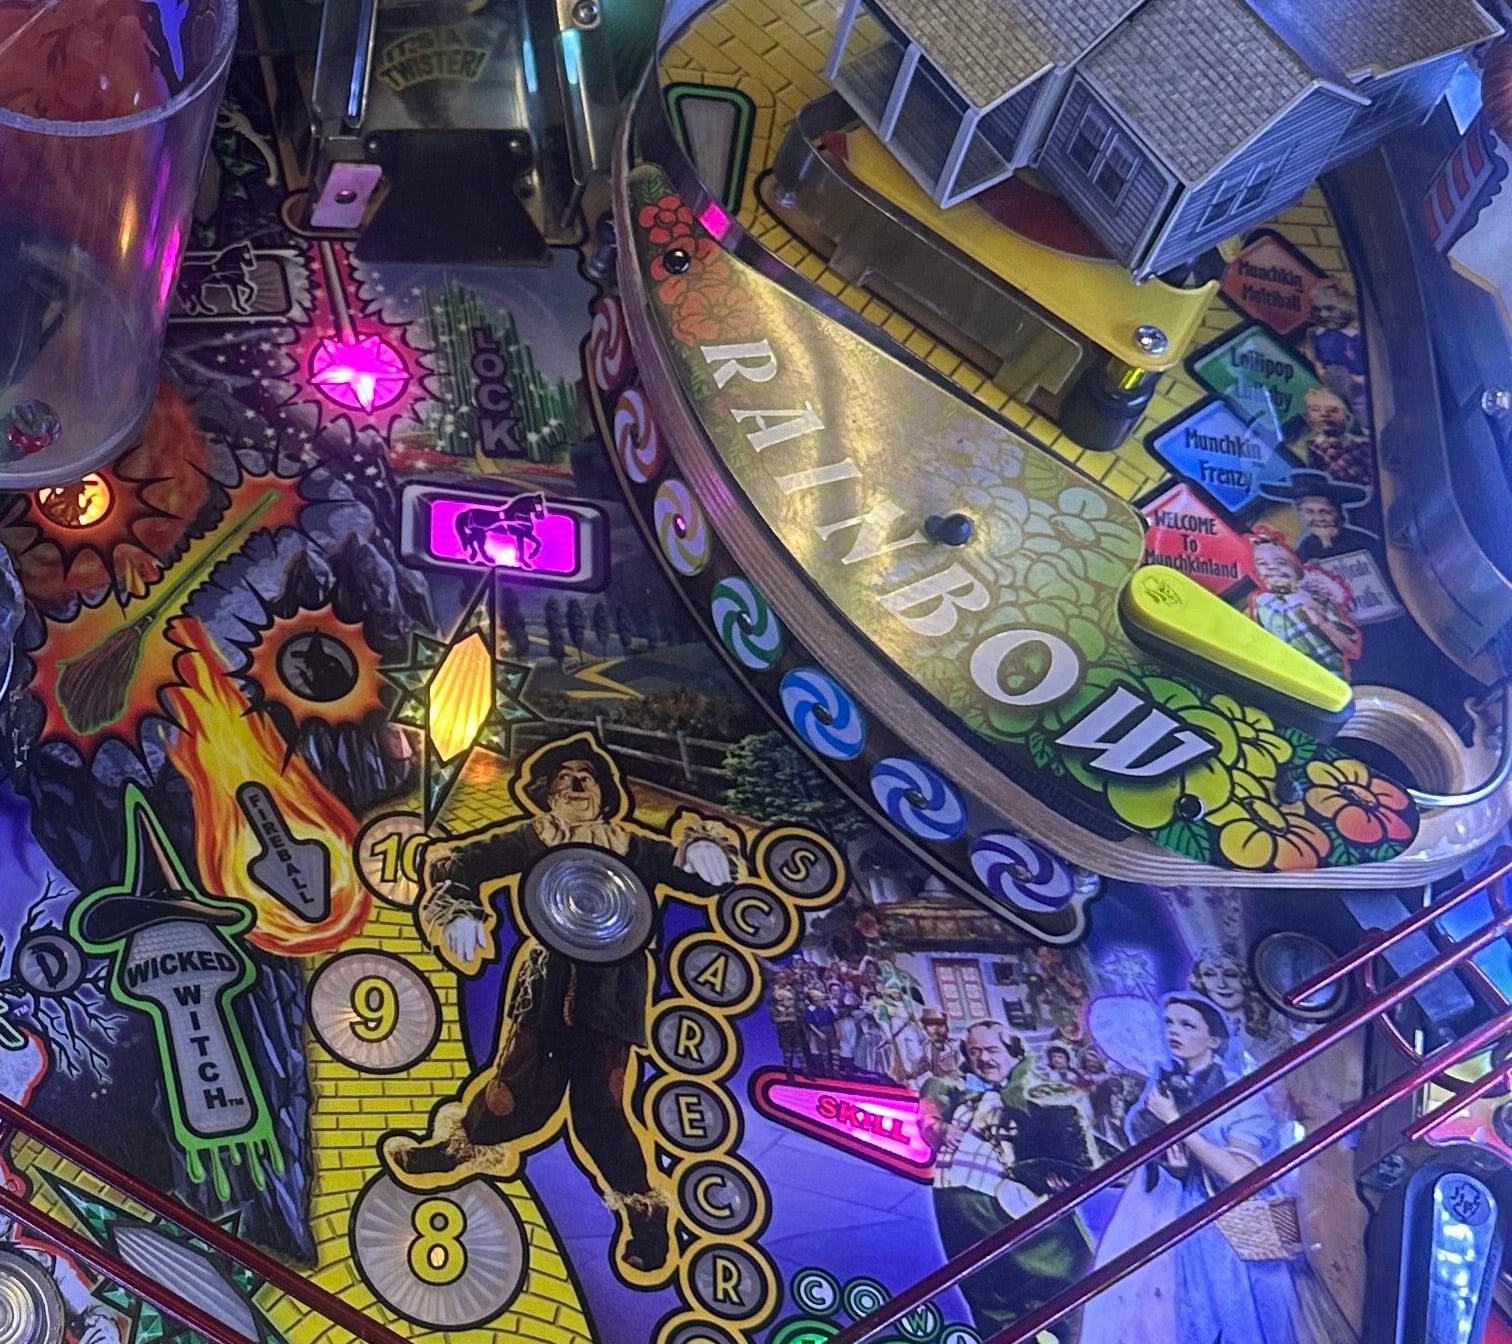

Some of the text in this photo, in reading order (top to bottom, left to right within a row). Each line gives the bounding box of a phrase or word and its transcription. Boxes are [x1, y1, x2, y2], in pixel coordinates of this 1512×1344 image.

[1238, 258, 1303, 288] Munchkin
[1242, 283, 1302, 312] Multiball
[1231, 347, 1295, 383] Lollipop
[471, 327, 521, 454] LOCK
[1184, 427, 1263, 462] Munchkin
[1198, 459, 1258, 495] Frenzy
[1153, 509, 1219, 536] WELCOME
[699, 338, 1220, 779] RAINBOW
[1180, 534, 1200, 553] To
[1144, 549, 1239, 580] Munchkinland
[247, 793, 316, 907] FIREBALL
[126, 950, 238, 990] WICKED
[348, 973, 401, 1044] 9
[172, 984, 230, 1111] WITCH
[815, 1093, 915, 1147] SKILL
[406, 1195, 470, 1288] 8
